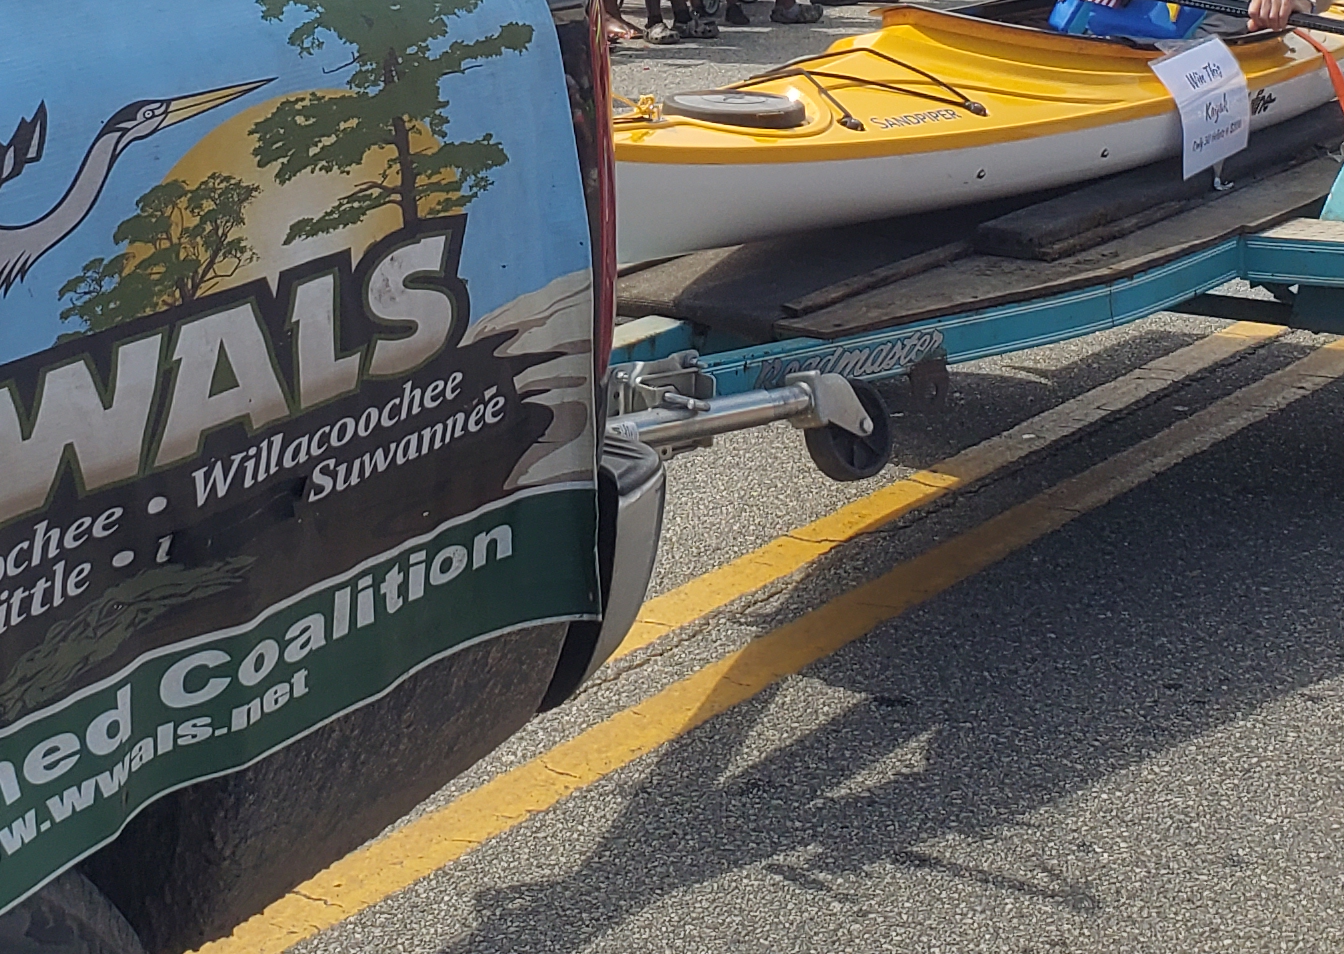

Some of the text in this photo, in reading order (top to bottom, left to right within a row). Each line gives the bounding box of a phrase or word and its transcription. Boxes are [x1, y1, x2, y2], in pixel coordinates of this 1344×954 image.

[1185, 62, 1223, 90] Win This
[869, 108, 963, 130] SANDPIPER
[1204, 92, 1229, 124] Kayak
[191, 370, 464, 508] Willacoochee
[159, 523, 514, 709] Coalition
